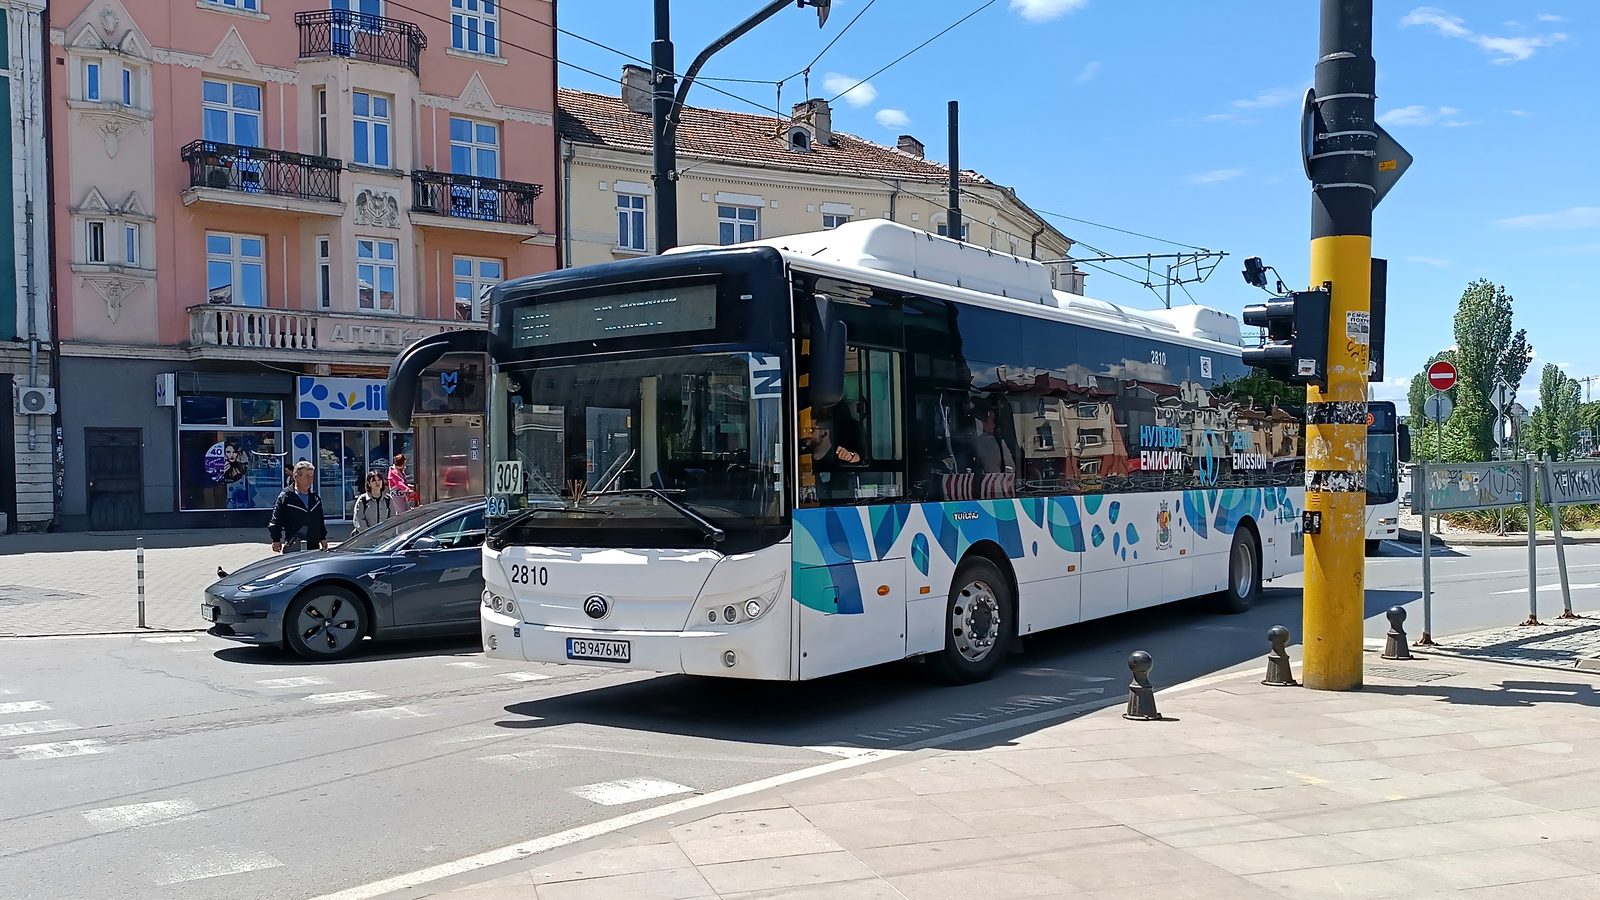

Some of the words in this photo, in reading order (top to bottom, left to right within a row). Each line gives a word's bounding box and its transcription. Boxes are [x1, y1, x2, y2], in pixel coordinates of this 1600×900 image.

[330, 323, 425, 346] АПТЕК
[1150, 350, 1167, 366] 2810
[366, 384, 388, 411] lil
[1140, 425, 1183, 448] НУЛЕВИ
[1140, 450, 1182, 470] ЕМИСИИ
[1232, 452, 1267, 470] EMISSION
[496, 463, 519, 492] 309
[511, 564, 548, 586] 2810
[573, 641, 587, 655] CB
[588, 642, 612, 656] 9476
[613, 643, 627, 657] MX
